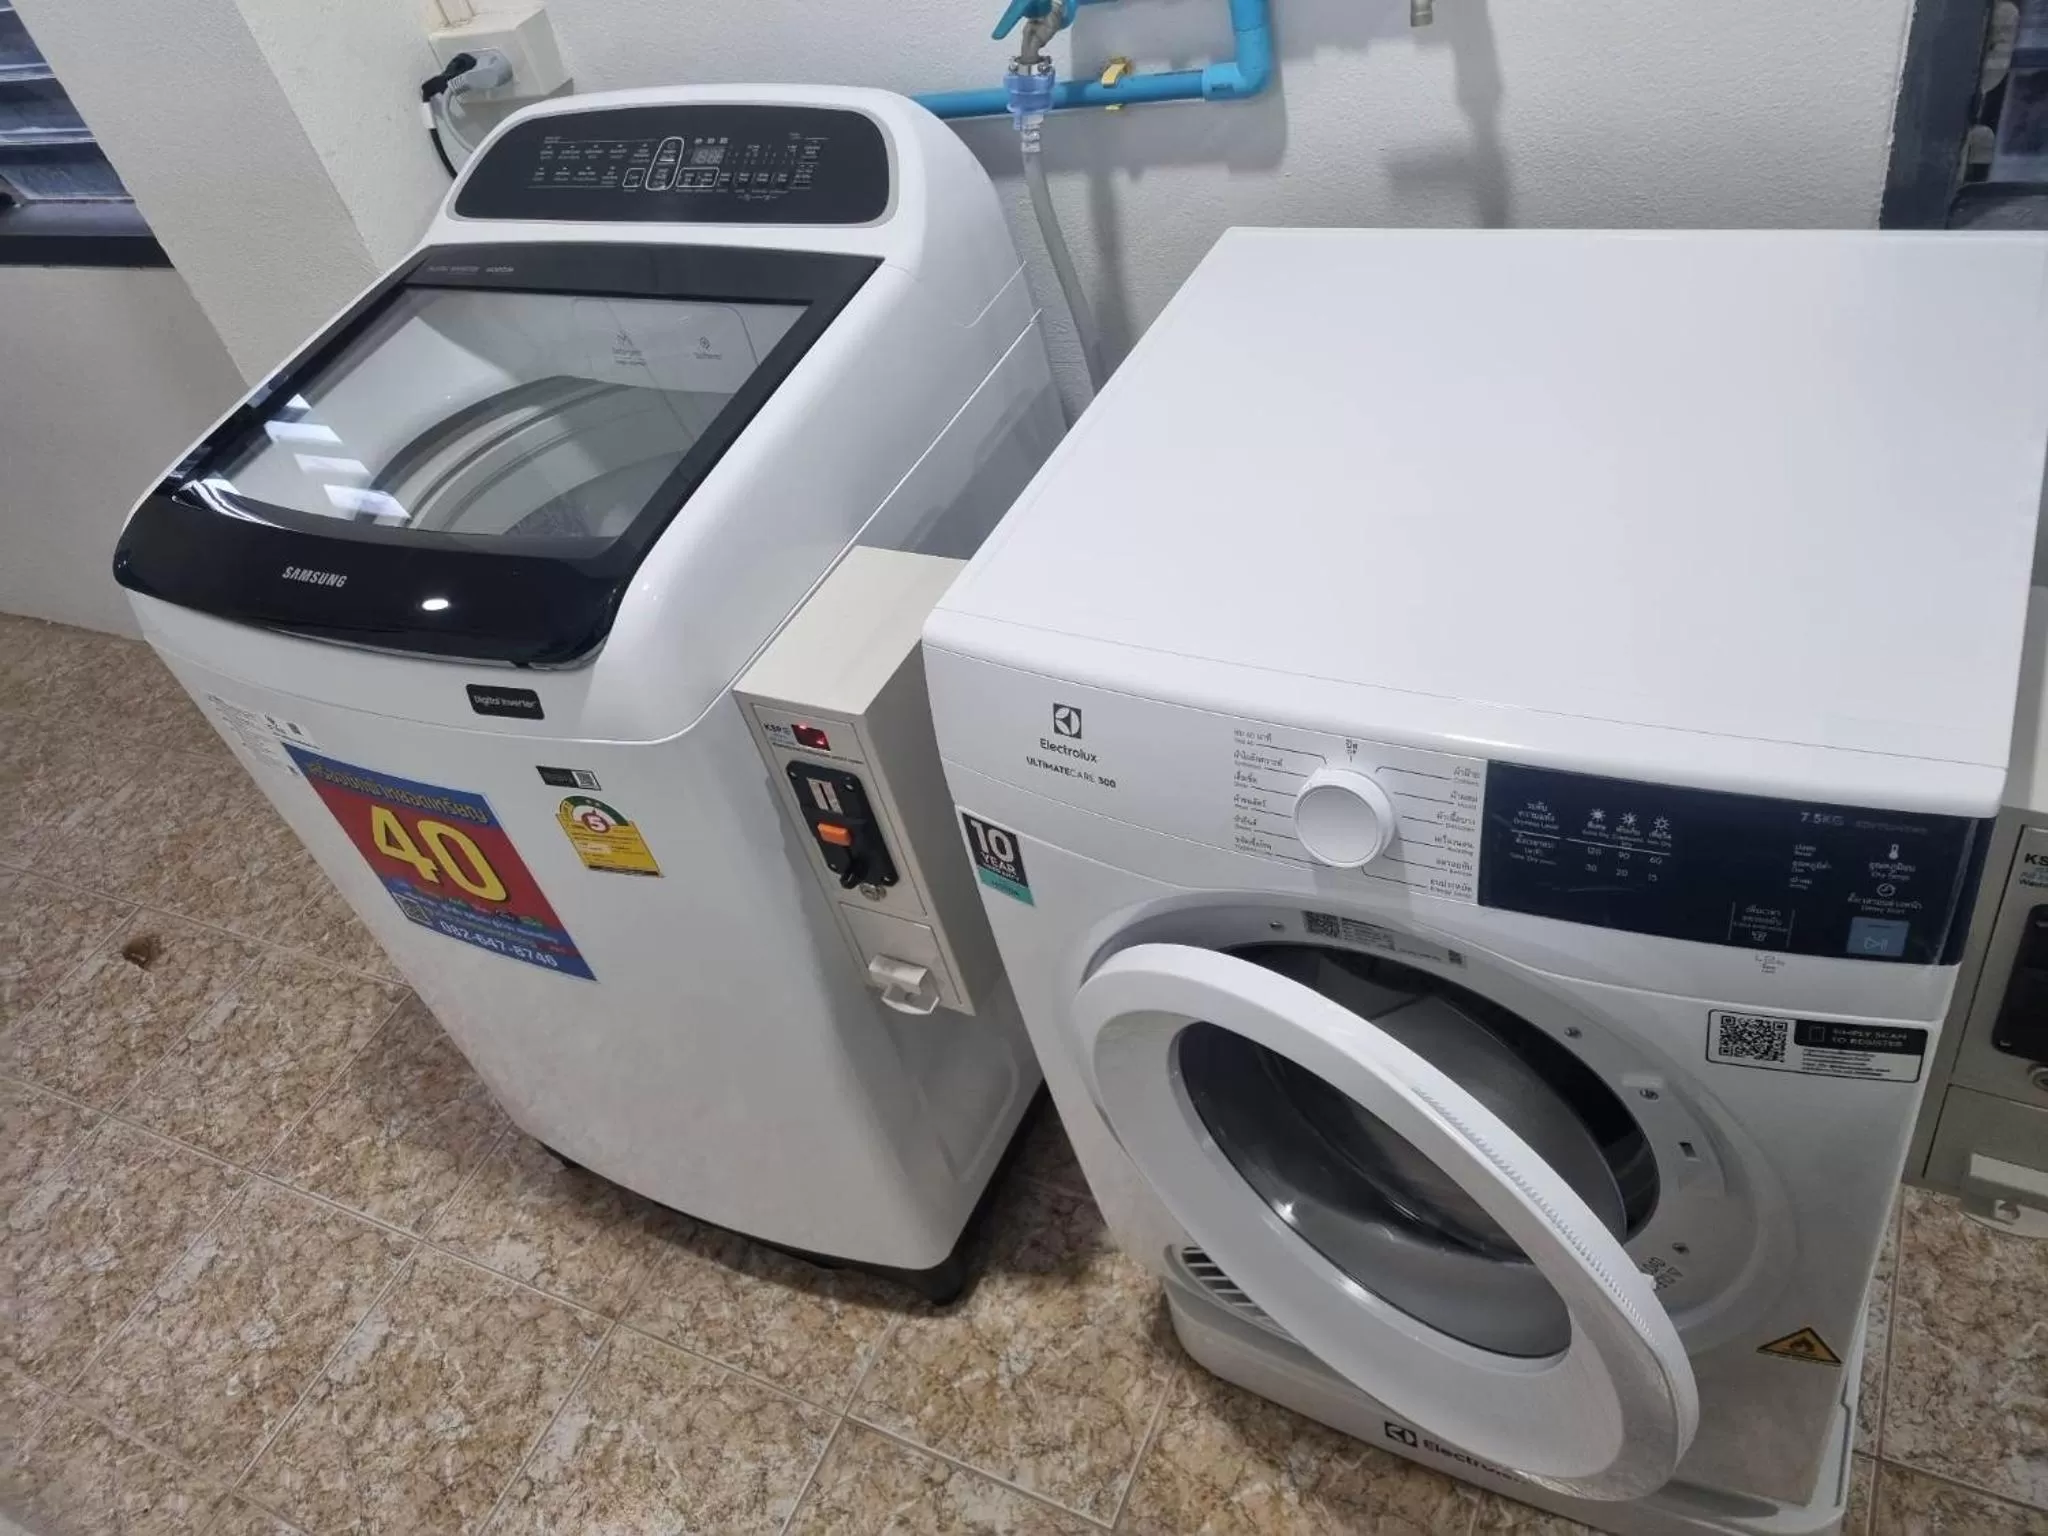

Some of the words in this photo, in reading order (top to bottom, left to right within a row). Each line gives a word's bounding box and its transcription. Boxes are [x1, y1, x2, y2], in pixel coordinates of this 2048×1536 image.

[282, 565, 347, 588] SAMSUNG
[474, 695, 501, 706] Digital
[1040, 738, 1098, 763] Electrolux
[1026, 756, 1095, 783] ULTIMATECARE
[587, 816, 605, 831] 5
[371, 804, 507, 903] 40
[970, 819, 1014, 863] 10
[981, 851, 1017, 874] YEAR
[1423, 1439, 1521, 1482] Electro
